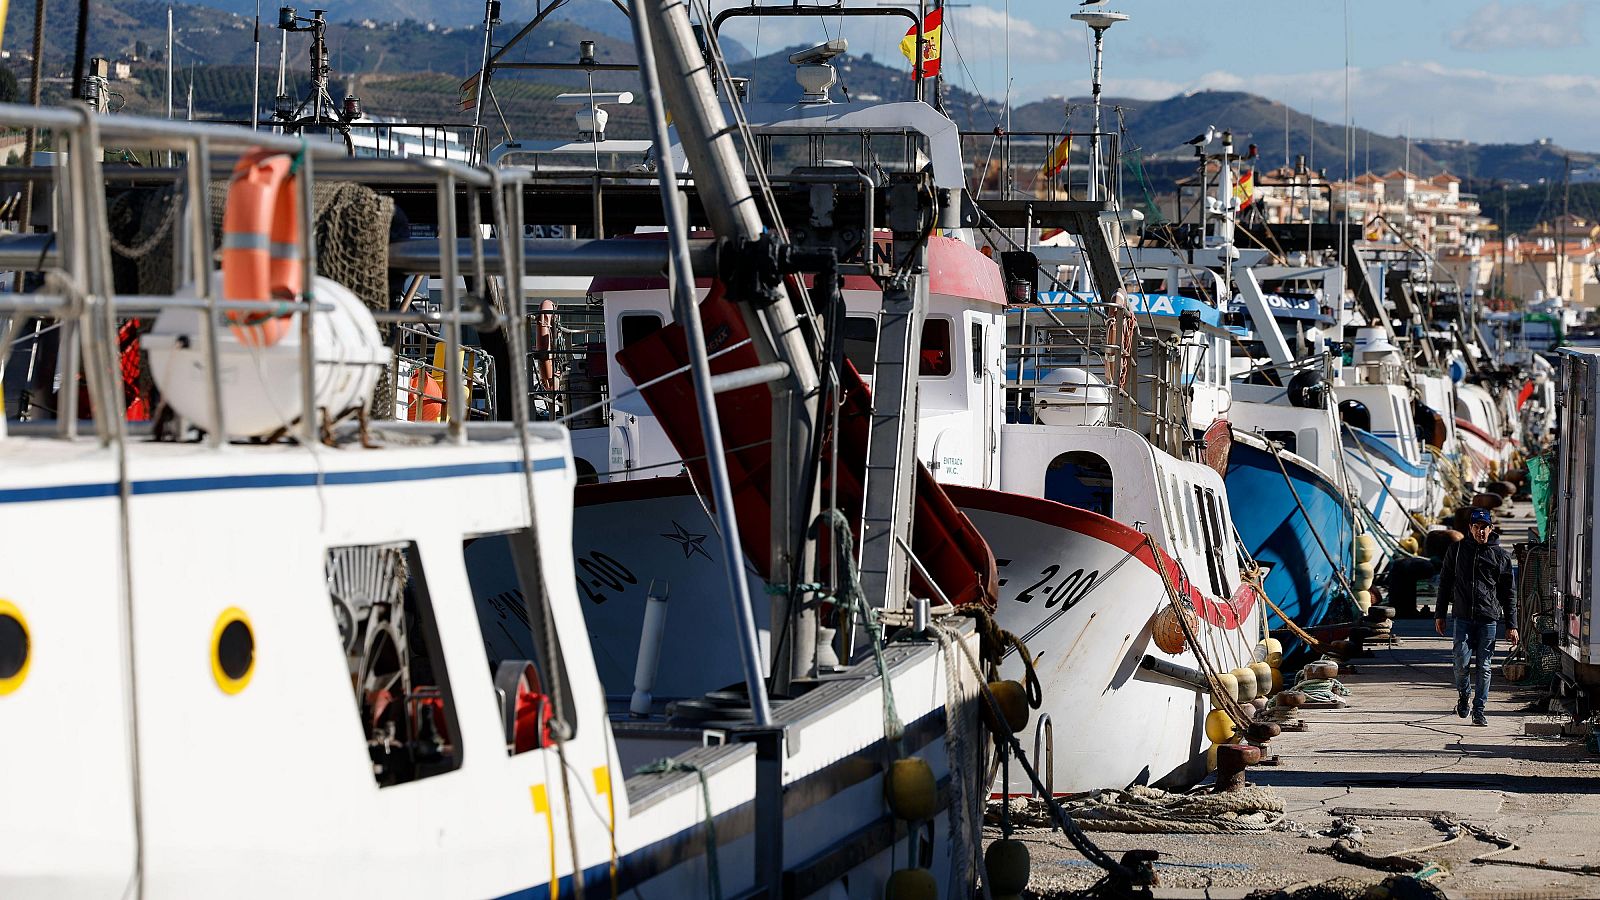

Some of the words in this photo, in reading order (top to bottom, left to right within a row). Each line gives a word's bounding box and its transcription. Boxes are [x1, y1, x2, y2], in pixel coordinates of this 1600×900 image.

[1040, 292, 1176, 314] VITRIA
[1232, 293, 1310, 310] ATONIO
[1014, 564, 1099, 612] 2-00
